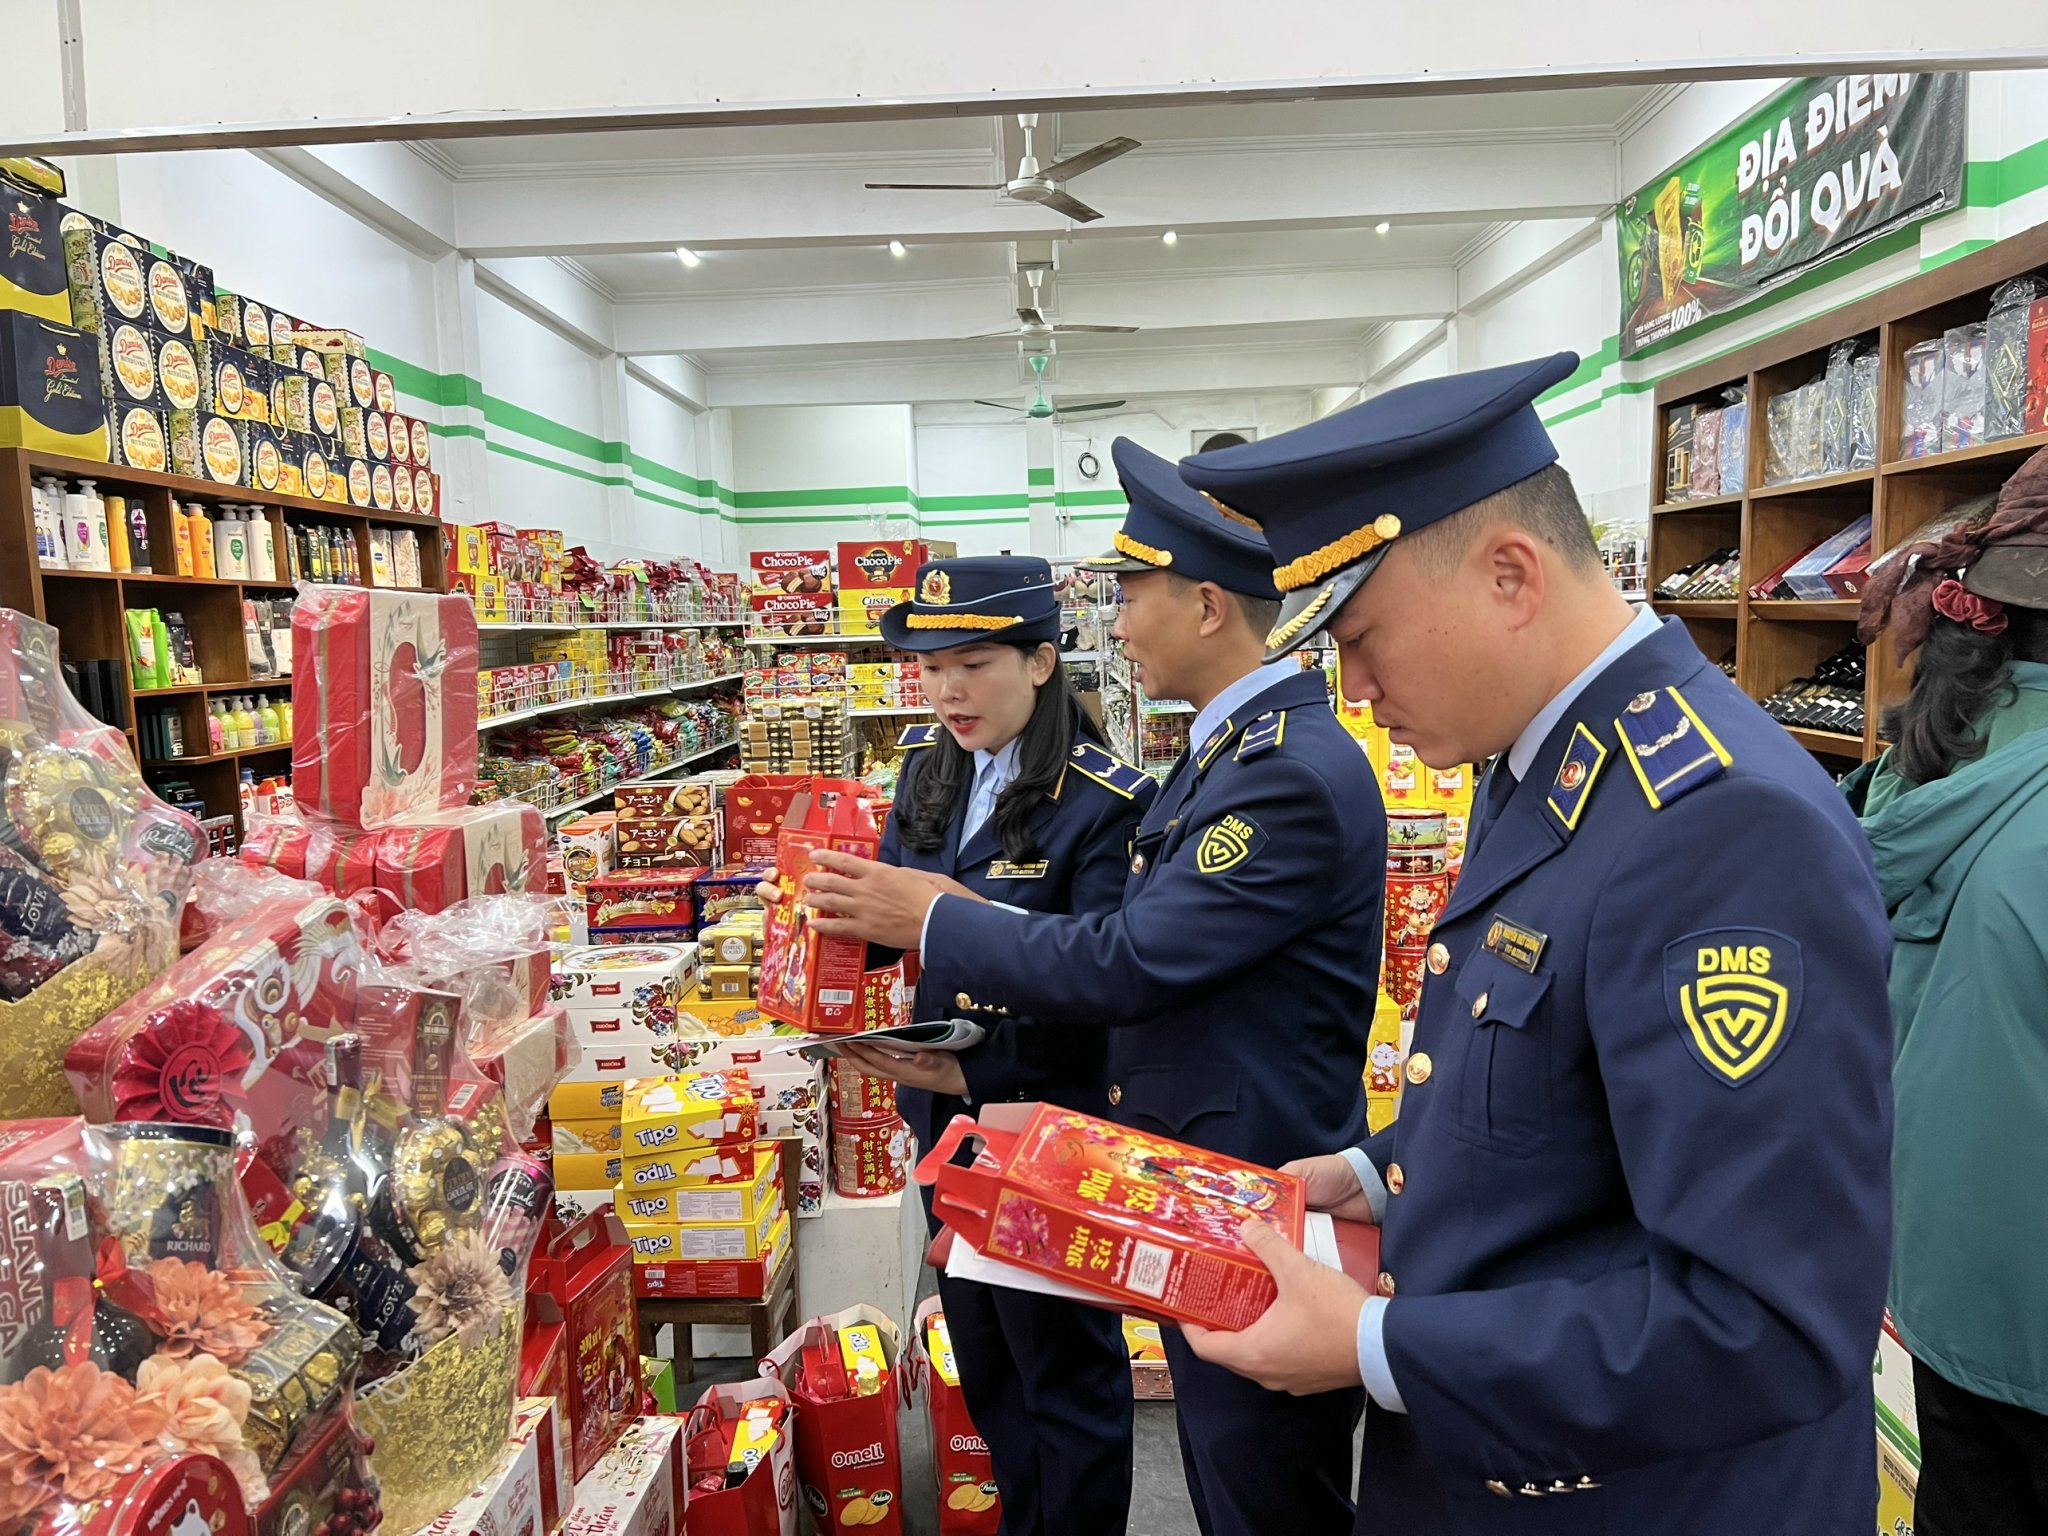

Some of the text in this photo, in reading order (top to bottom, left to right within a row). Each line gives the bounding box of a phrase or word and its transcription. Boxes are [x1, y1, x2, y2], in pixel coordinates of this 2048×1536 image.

[1737, 117, 1797, 193] ĐỊA
[1740, 176, 1800, 266] ĐỔI
[1811, 125, 1902, 233] QUÀ
[107, 255, 133, 271] Danisa
[154, 274, 178, 289] Danisa
[1669, 298, 1702, 332] 100%
[862, 596, 895, 605] Custas
[626, 794, 663, 804] アーモンド
[630, 829, 667, 837] アーモンド
[1221, 814, 1253, 840] DMS
[621, 857, 651, 867] チョコ
[22, 887, 47, 933] LOVE
[1697, 946, 1771, 974] DMS
[686, 1074, 729, 1100] Tipo
[635, 1124, 678, 1147] Tipo
[634, 1163, 677, 1185] Tipo
[1077, 1167, 1114, 1202] Mứt
[628, 1198, 668, 1216] Tipo
[1121, 1184, 1158, 1213] Tết
[167, 1240, 212, 1252] RICHARD
[632, 1235, 672, 1254] Tipo
[1065, 1225, 1090, 1268] Mứt
[1090, 1237, 1113, 1271] Tết
[647, 1280, 664, 1288] Tipo
[375, 1281, 405, 1329] LOVE
[849, 1331, 870, 1352] Tipo
[951, 1435, 989, 1451] Ome
[832, 1443, 885, 1469] Omeli
